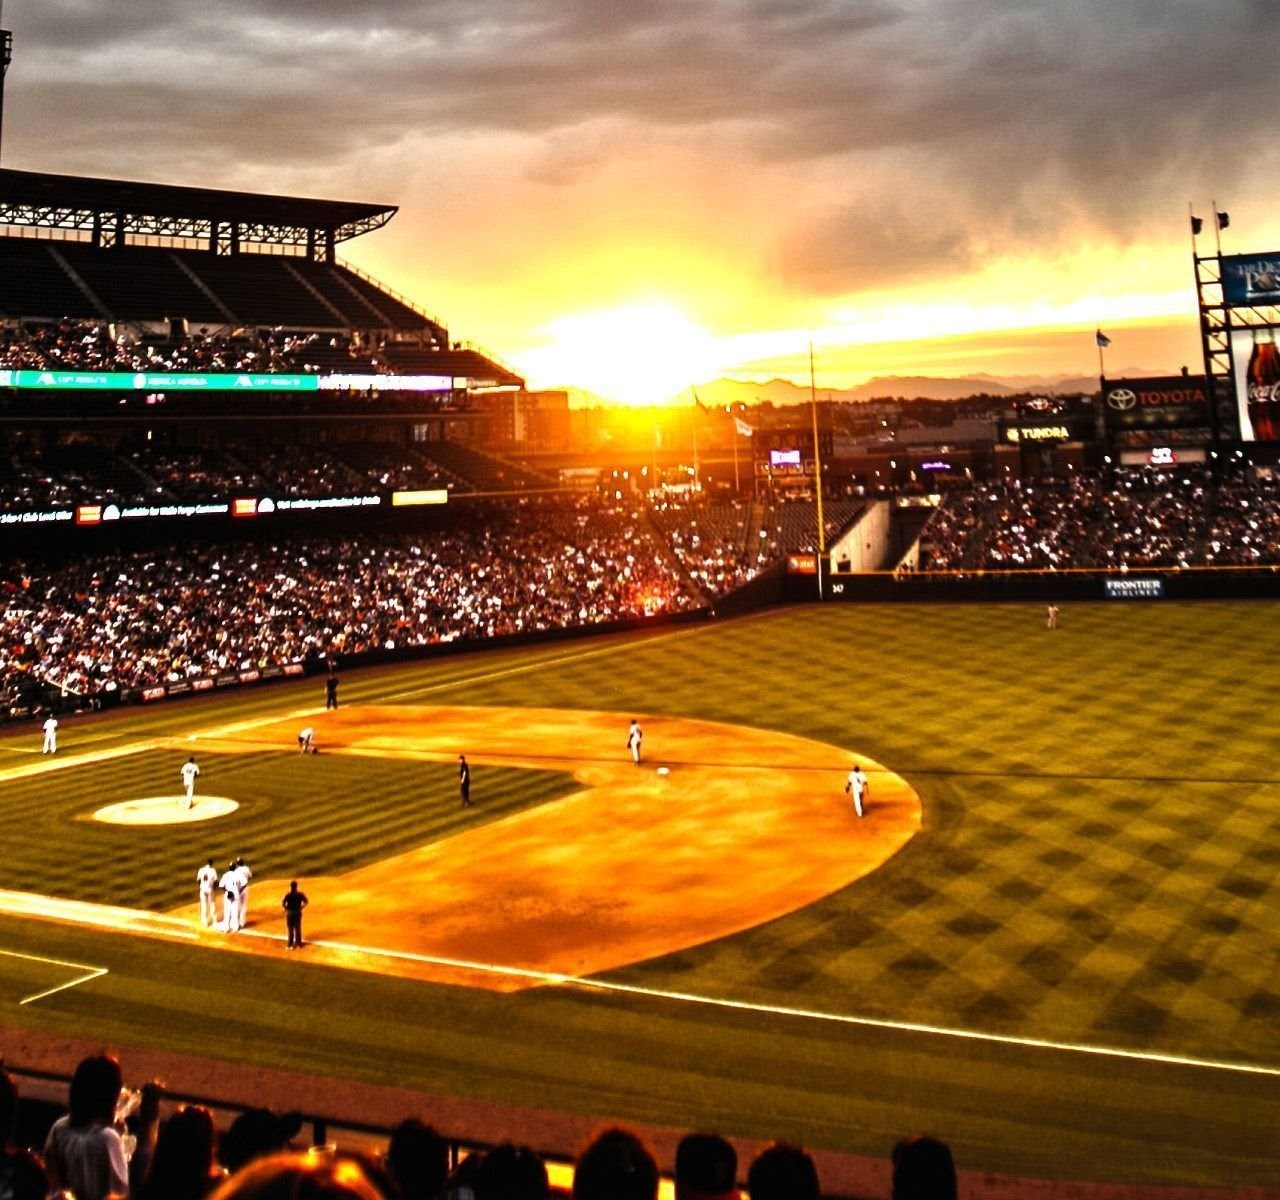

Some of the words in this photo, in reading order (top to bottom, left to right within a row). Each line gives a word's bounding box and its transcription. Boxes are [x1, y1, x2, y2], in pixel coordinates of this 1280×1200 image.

[1139, 389, 1205, 405] TOYOTA
[1021, 426, 1069, 440] TUNDRA
[1106, 580, 1161, 589] FRONTIER
[1111, 589, 1158, 597] AIRLINES
